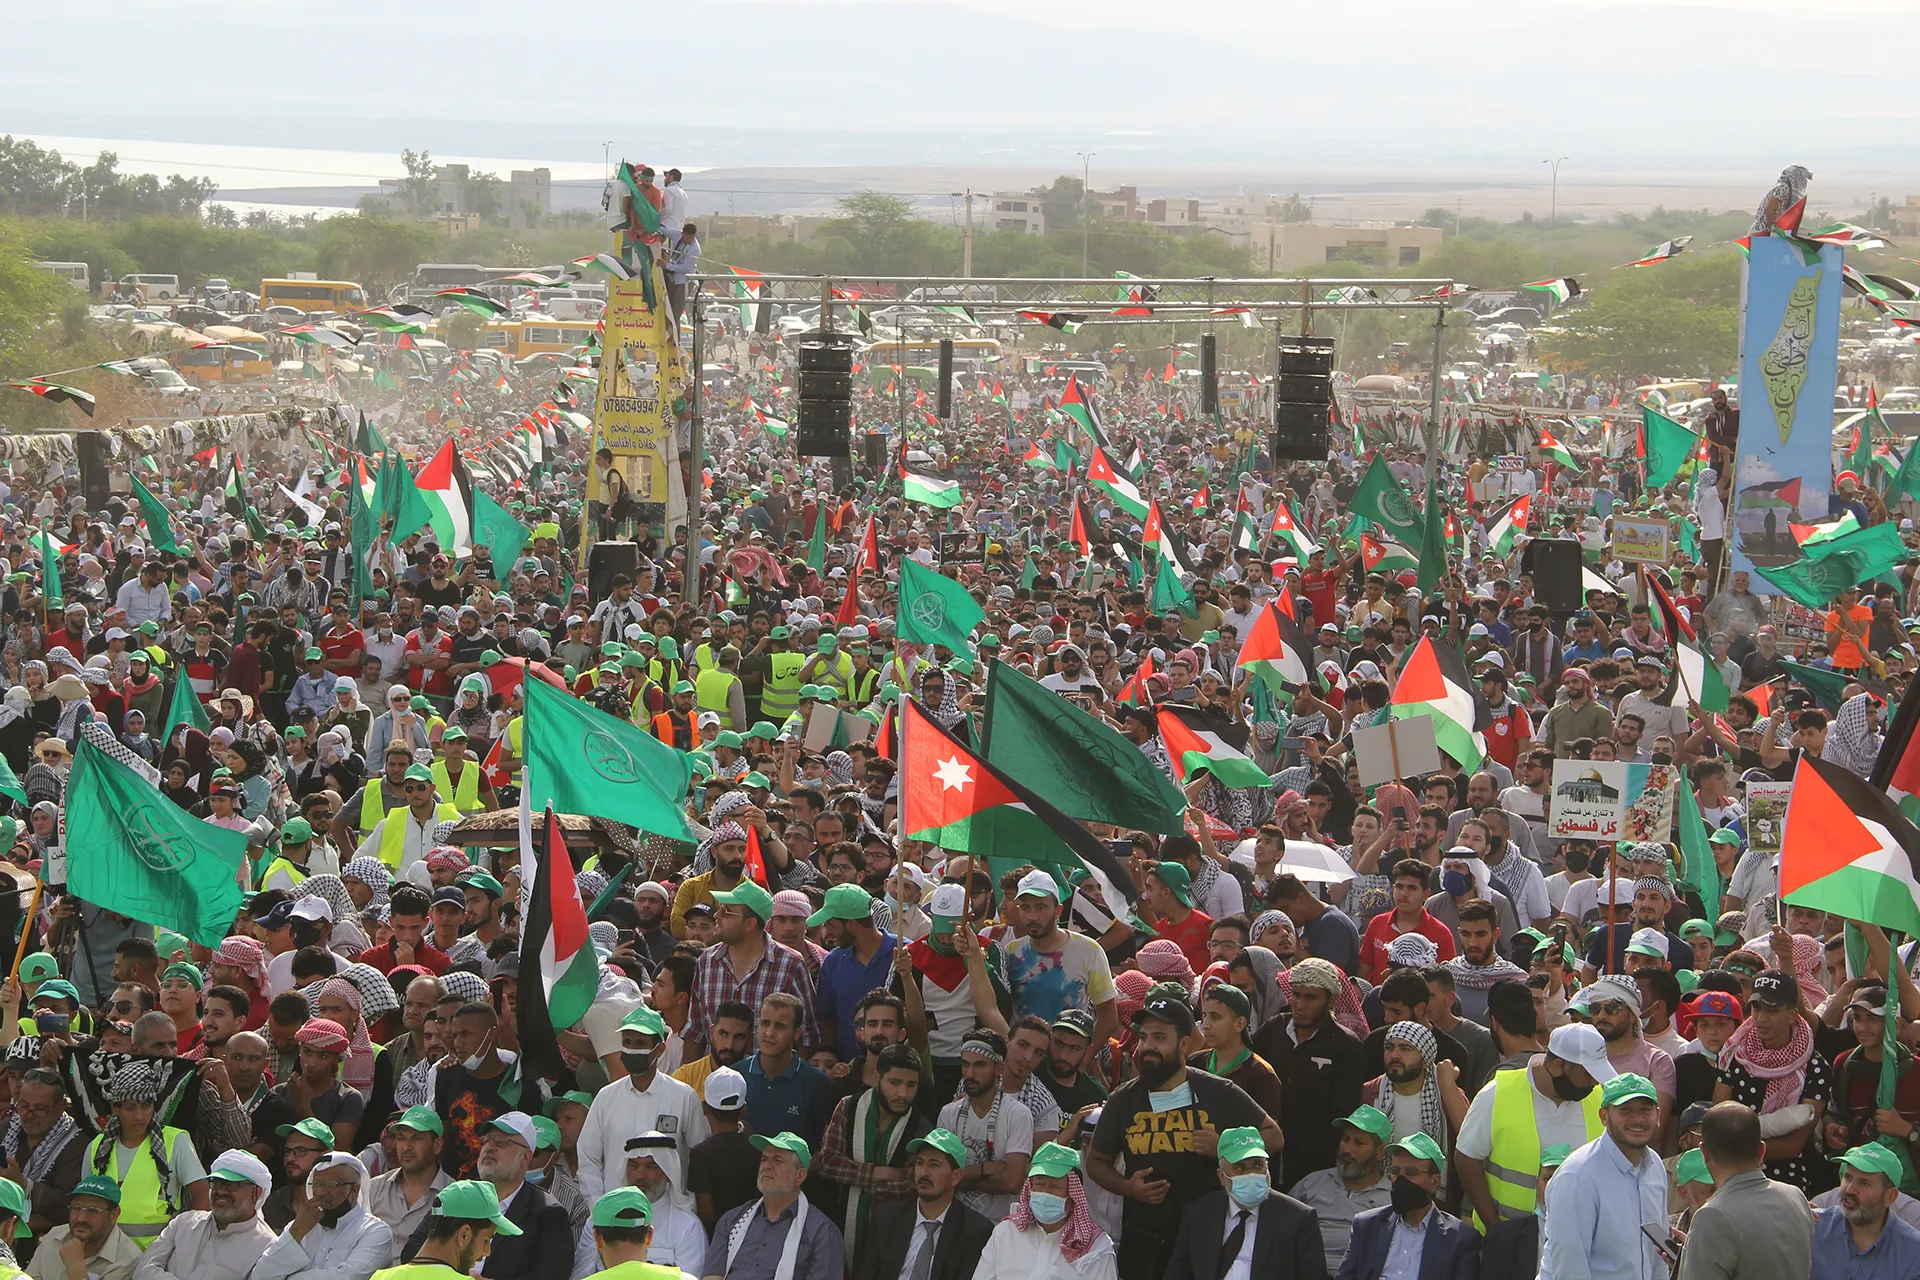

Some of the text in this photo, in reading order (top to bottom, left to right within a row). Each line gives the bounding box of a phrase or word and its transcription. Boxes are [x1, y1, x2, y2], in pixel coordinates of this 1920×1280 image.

[603, 399, 660, 413] 0788549947
[1561, 808, 1581, 817] فلسطين
[1593, 809, 1609, 818] تنازل
[1555, 818, 1618, 836] كل فلسطين
[1754, 976, 1780, 990] CPT
[1125, 1132, 1196, 1155] WAR
